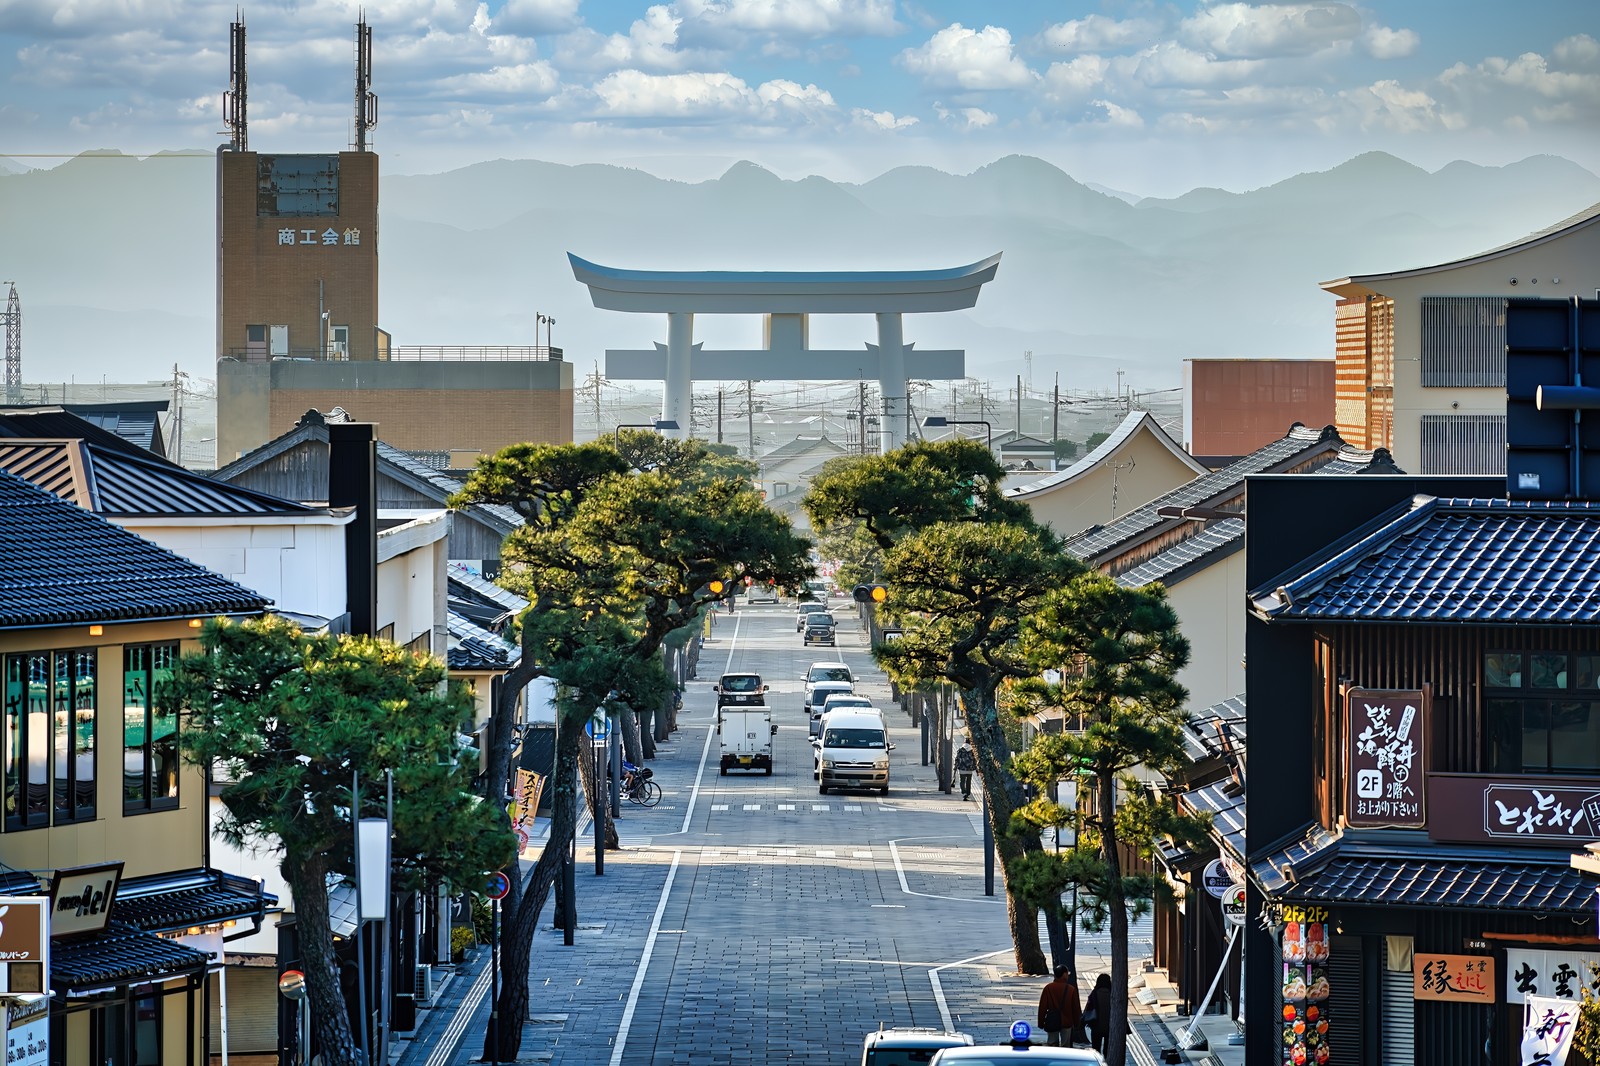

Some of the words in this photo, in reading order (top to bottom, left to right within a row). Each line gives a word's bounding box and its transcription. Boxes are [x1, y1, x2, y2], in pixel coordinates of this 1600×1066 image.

[278, 227, 361, 246] 商工会館
[1356, 725, 1418, 772] 海鮮丼
[1361, 776, 1379, 791] 2F
[1386, 782, 1414, 799] 2階へ
[1356, 800, 1419, 816] お上がり下さい!
[1283, 905, 1299, 922] 2F
[1306, 906, 1323, 923] 2F
[1465, 960, 1487, 973] 出雲
[1456, 972, 1487, 990] えにし
[1514, 961, 1600, 998] 出雲
